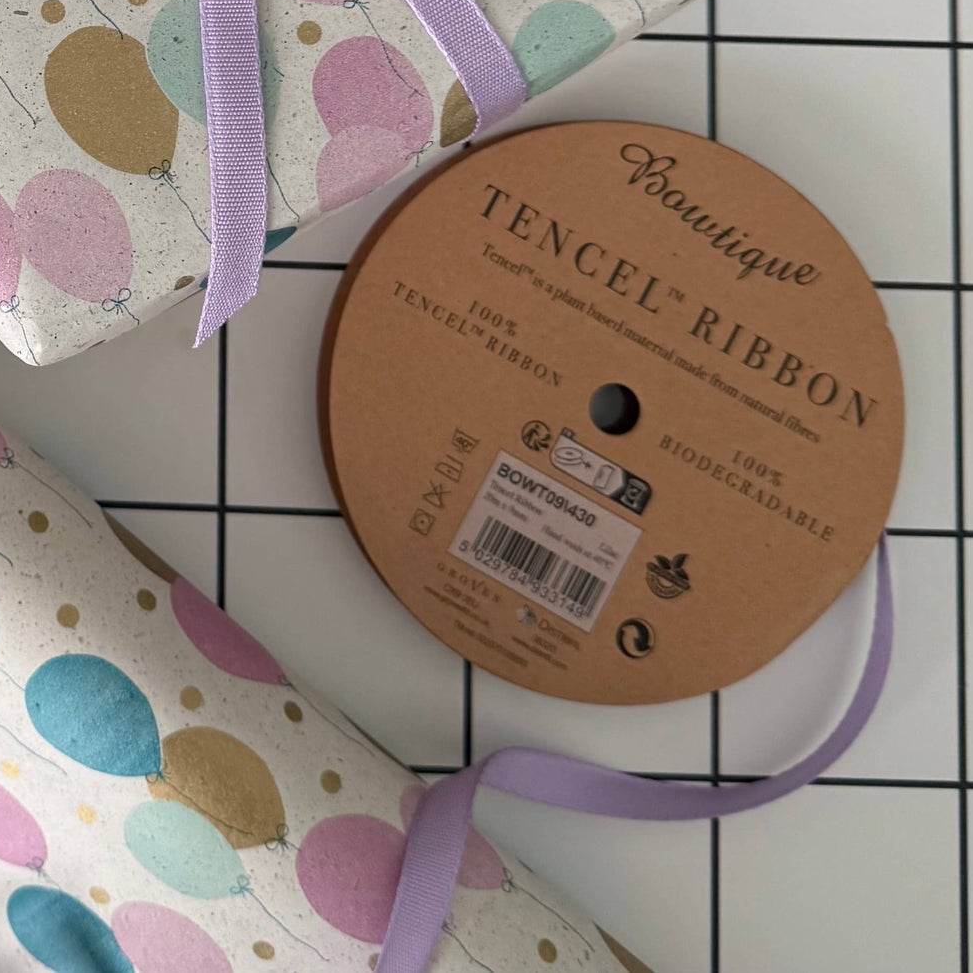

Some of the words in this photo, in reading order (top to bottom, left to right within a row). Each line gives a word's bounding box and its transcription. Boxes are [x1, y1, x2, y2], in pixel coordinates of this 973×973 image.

[620, 143, 821, 286] Bowtique
[468, 300, 518, 337] 100%
[485, 335, 563, 387] RIBBON
[532, 274, 545, 288] is
[545, 282, 553, 294] a
[551, 288, 587, 311] plant
[586, 303, 624, 333] based
[623, 326, 676, 362] material
[674, 355, 708, 380] made
[708, 373, 739, 398] from
[739, 393, 785, 423] natural
[784, 415, 821, 443] fibres
[689, 304, 878, 428] RIBBON
[497, 463, 596, 527] BOWT09\430
[658, 434, 835, 542] BIODEGRADABLE
[731, 450, 784, 487] 100%
[458, 539, 470, 552] 5
